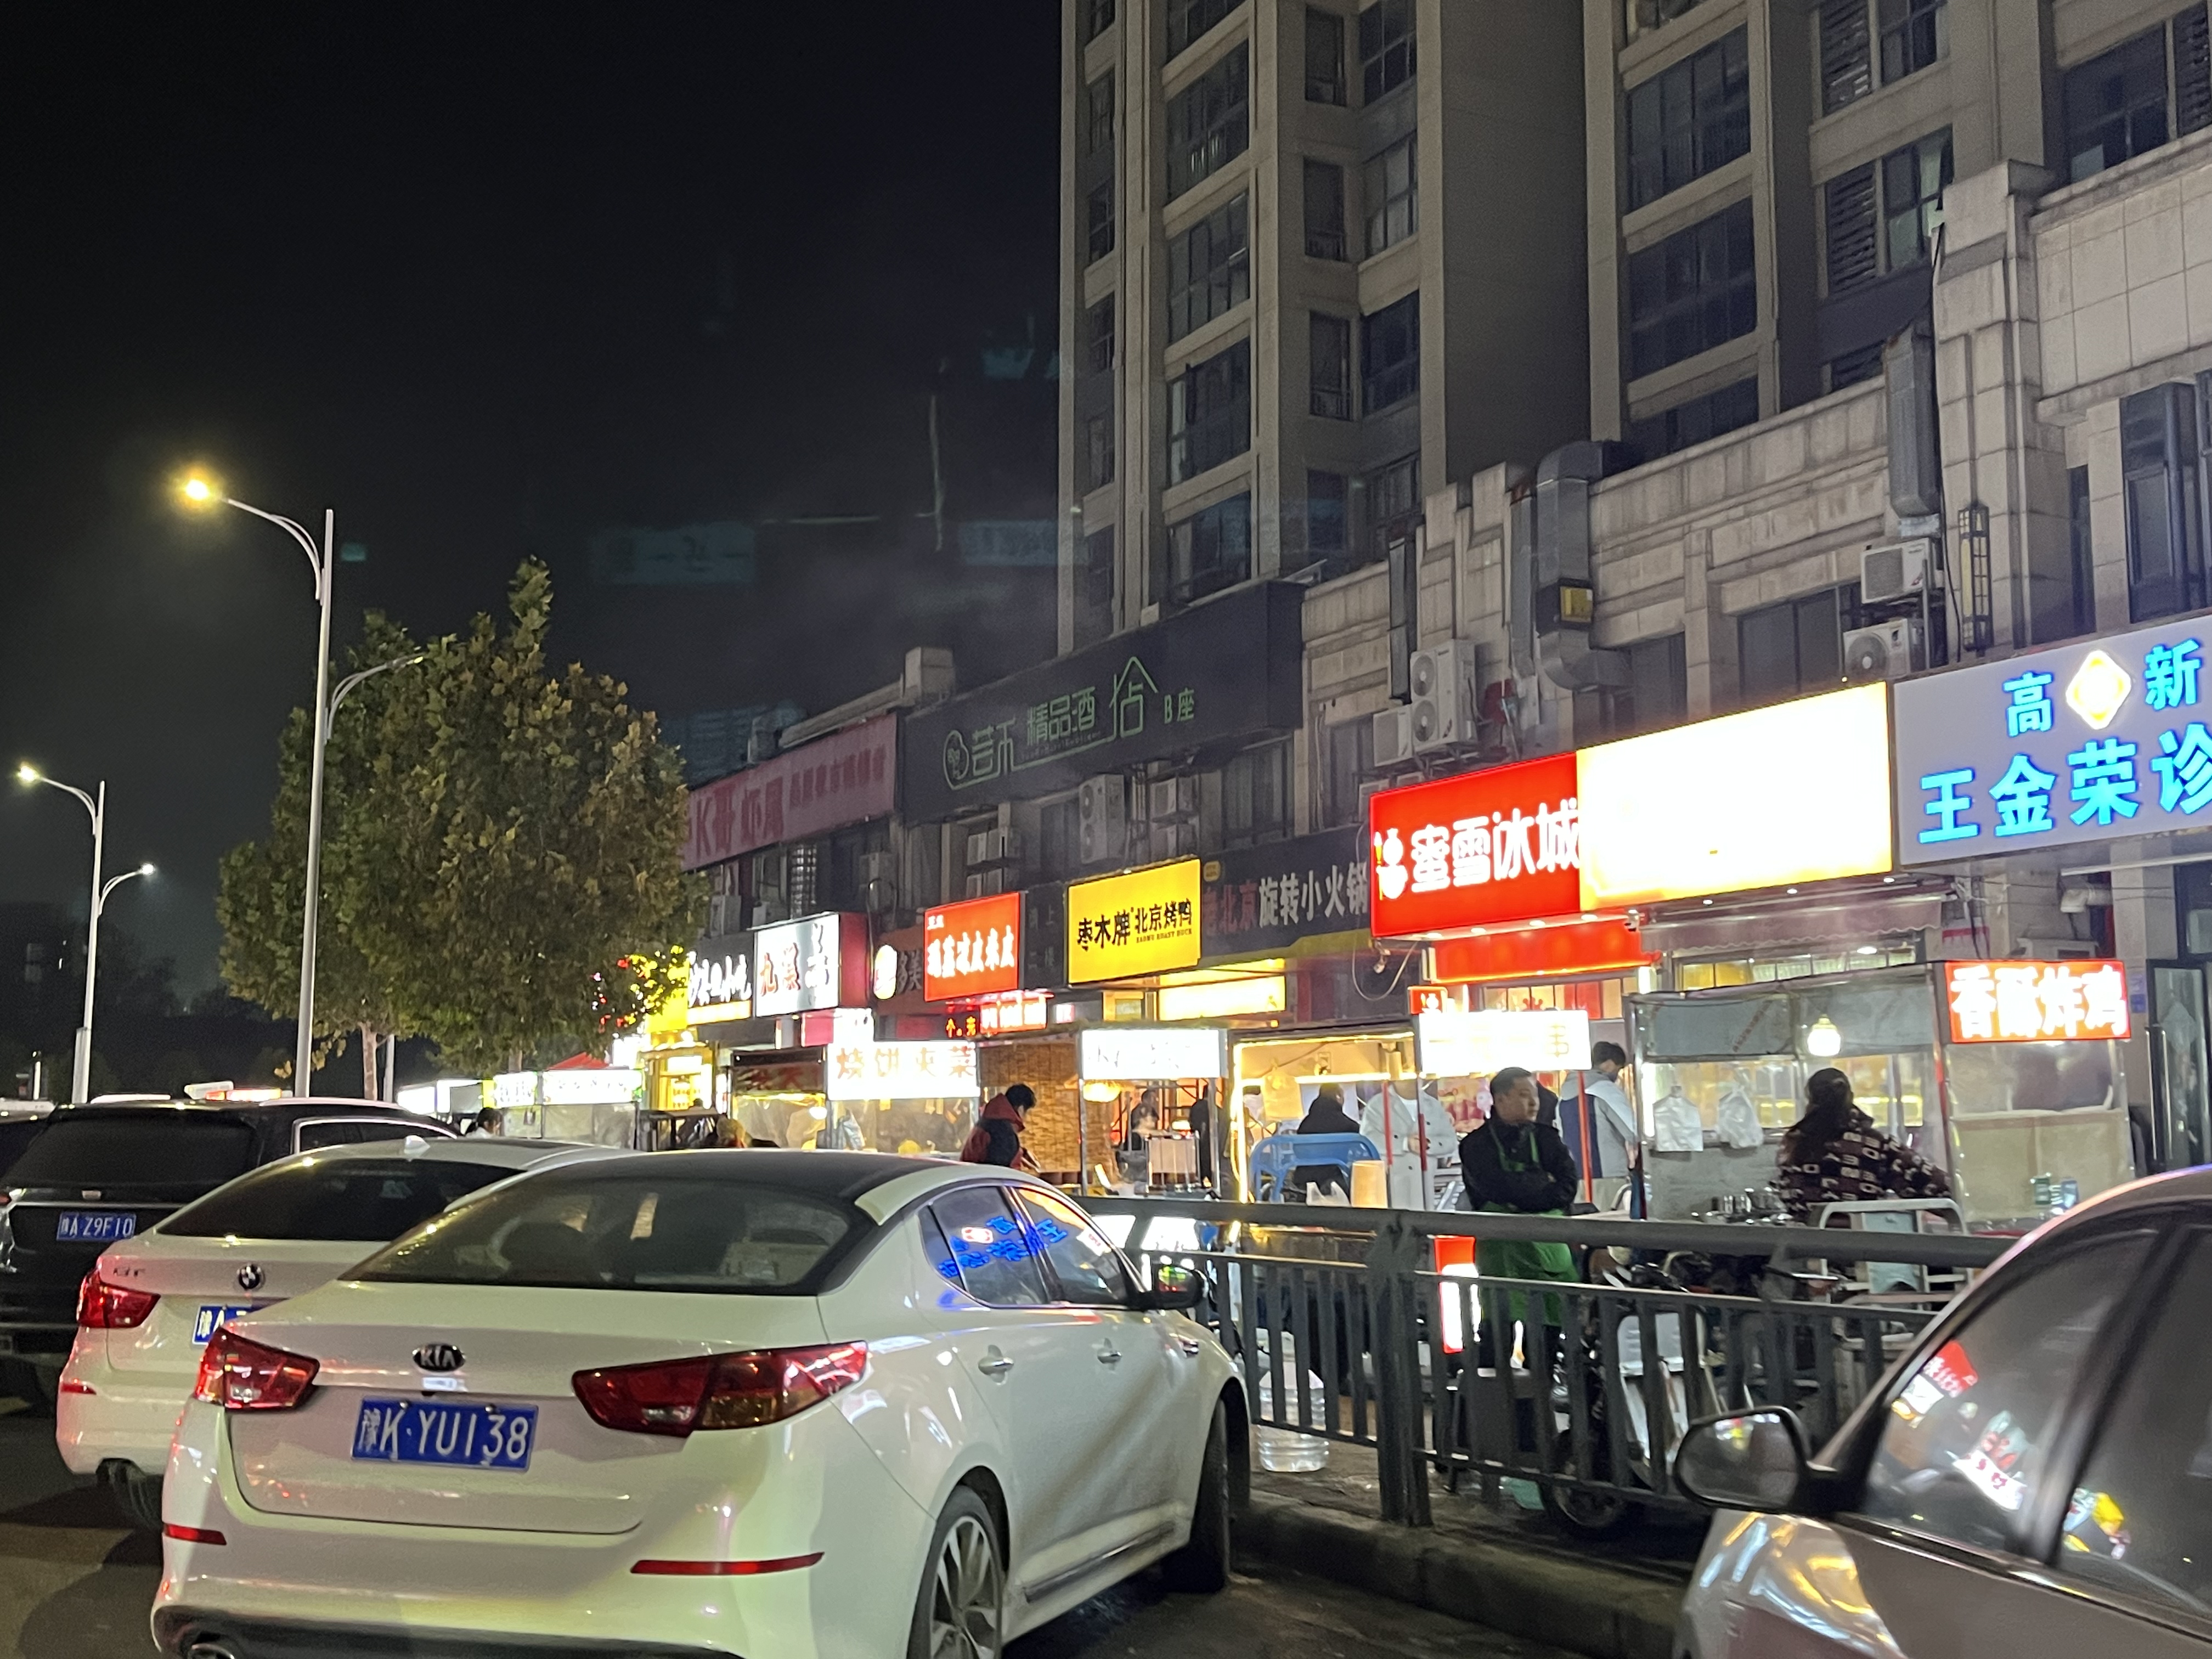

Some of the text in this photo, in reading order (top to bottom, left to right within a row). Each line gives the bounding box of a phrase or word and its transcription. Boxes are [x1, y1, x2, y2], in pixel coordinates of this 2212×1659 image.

[2002, 638, 2202, 737] 高 新
[1917, 723, 2212, 845] 王金荣诊
[1410, 797, 1581, 893] 蜜雪冰城
[1077, 898, 1192, 952] 枣木牌 北京烤鸭
[836, 1045, 976, 1080] 烧饼夹菜
[420, 1345, 455, 1367] KIA
